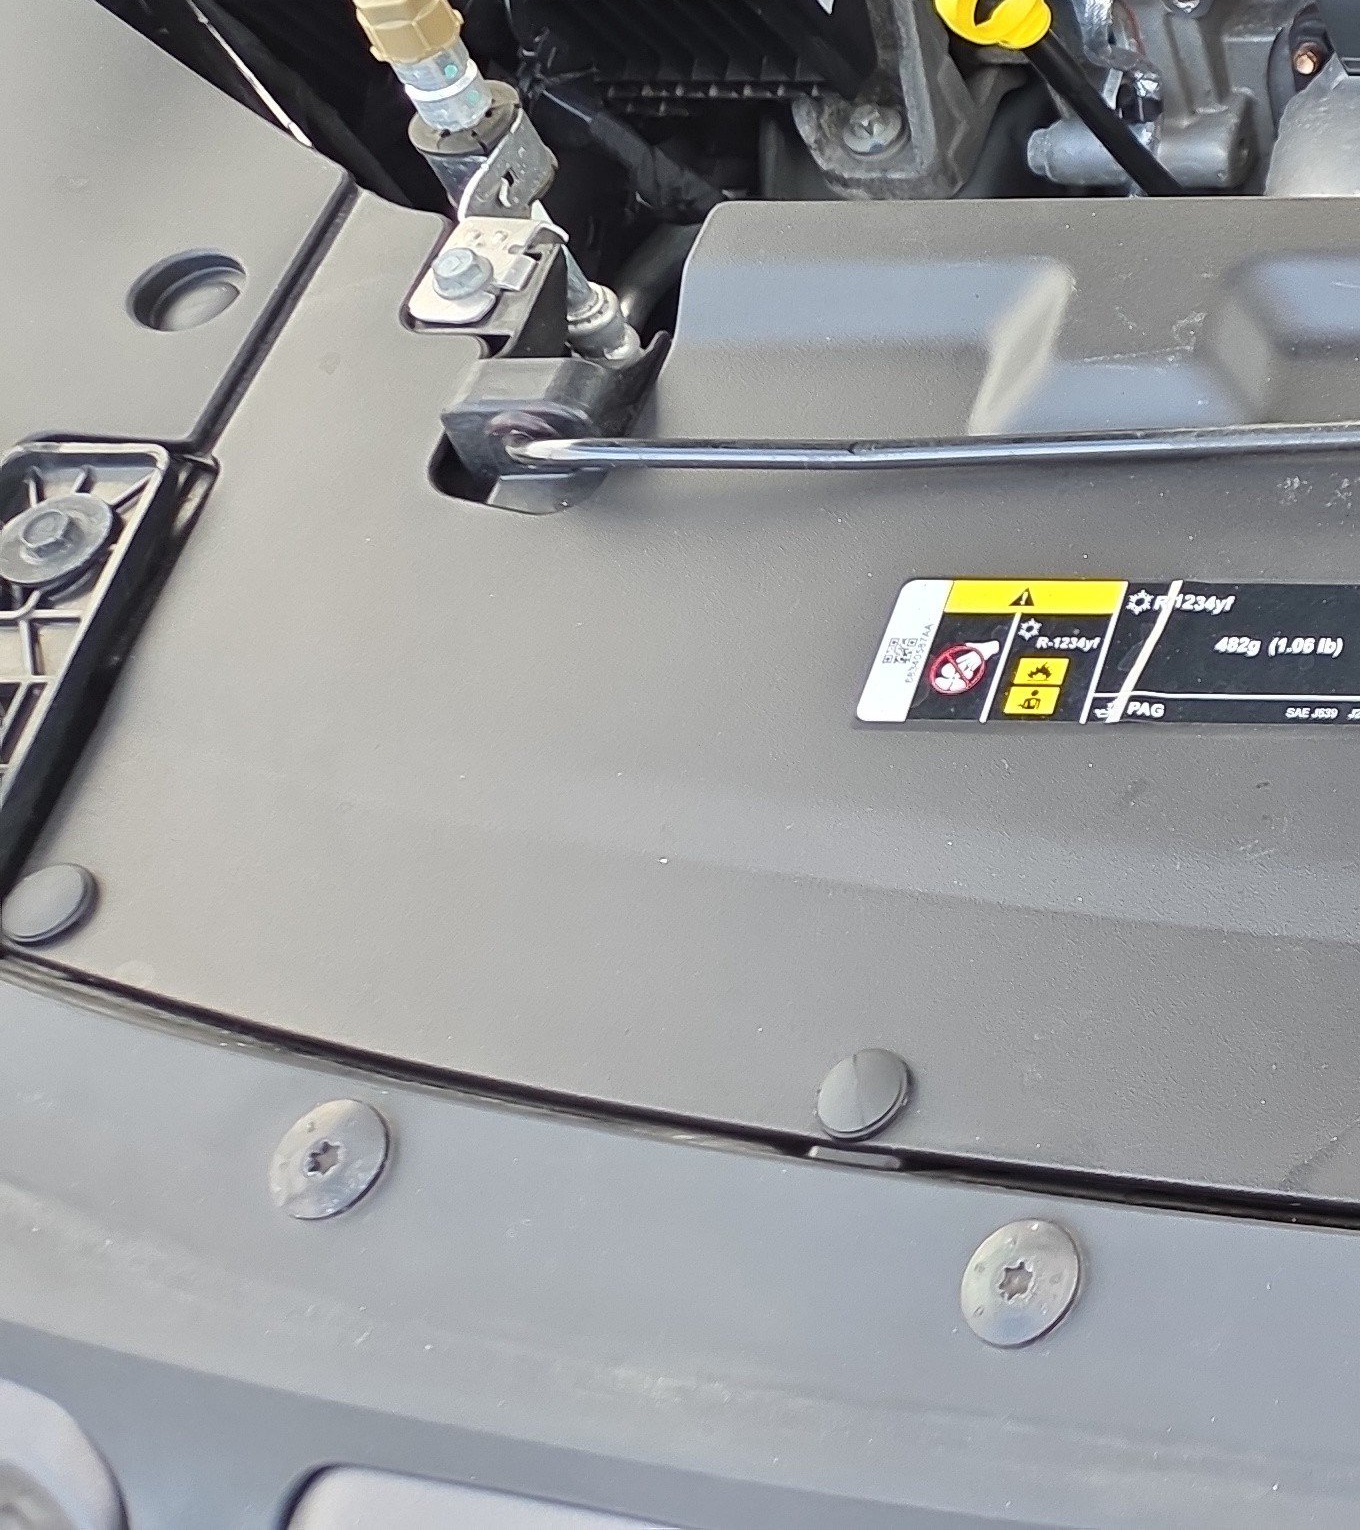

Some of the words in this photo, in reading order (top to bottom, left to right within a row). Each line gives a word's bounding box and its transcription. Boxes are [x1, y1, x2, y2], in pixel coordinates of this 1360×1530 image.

[1152, 592, 1236, 616] R1234yf
[1036, 636, 1101, 653] R-1234yf
[1213, 636, 1262, 658] 482g
[1267, 636, 1316, 658] (1.06
[1316, 637, 1344, 659] lb)
[1127, 701, 1165, 718] PAG
[1285, 707, 1311, 719] SAE
